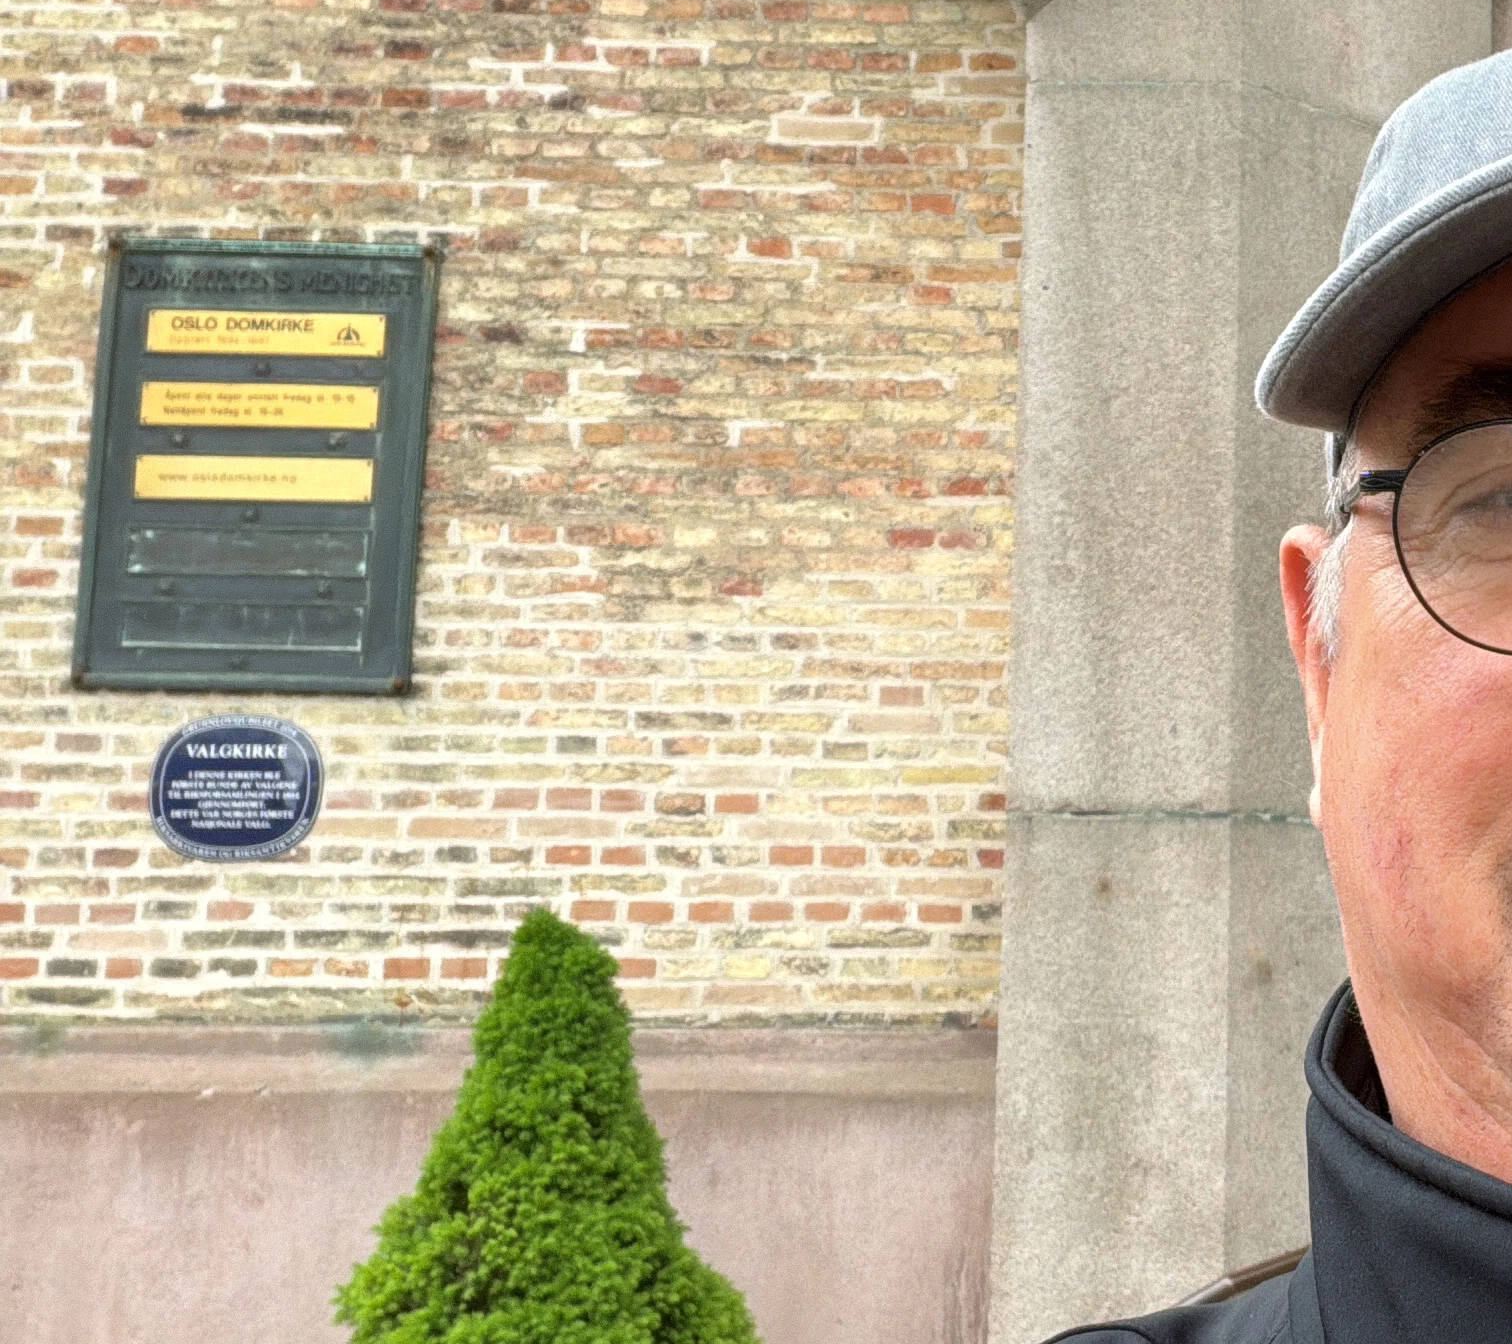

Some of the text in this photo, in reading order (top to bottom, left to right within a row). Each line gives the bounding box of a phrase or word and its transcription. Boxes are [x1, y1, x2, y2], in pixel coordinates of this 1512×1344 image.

[171, 315, 315, 333] OSLO DOMKIRKE
[186, 743, 289, 760] VALGKIRKE
